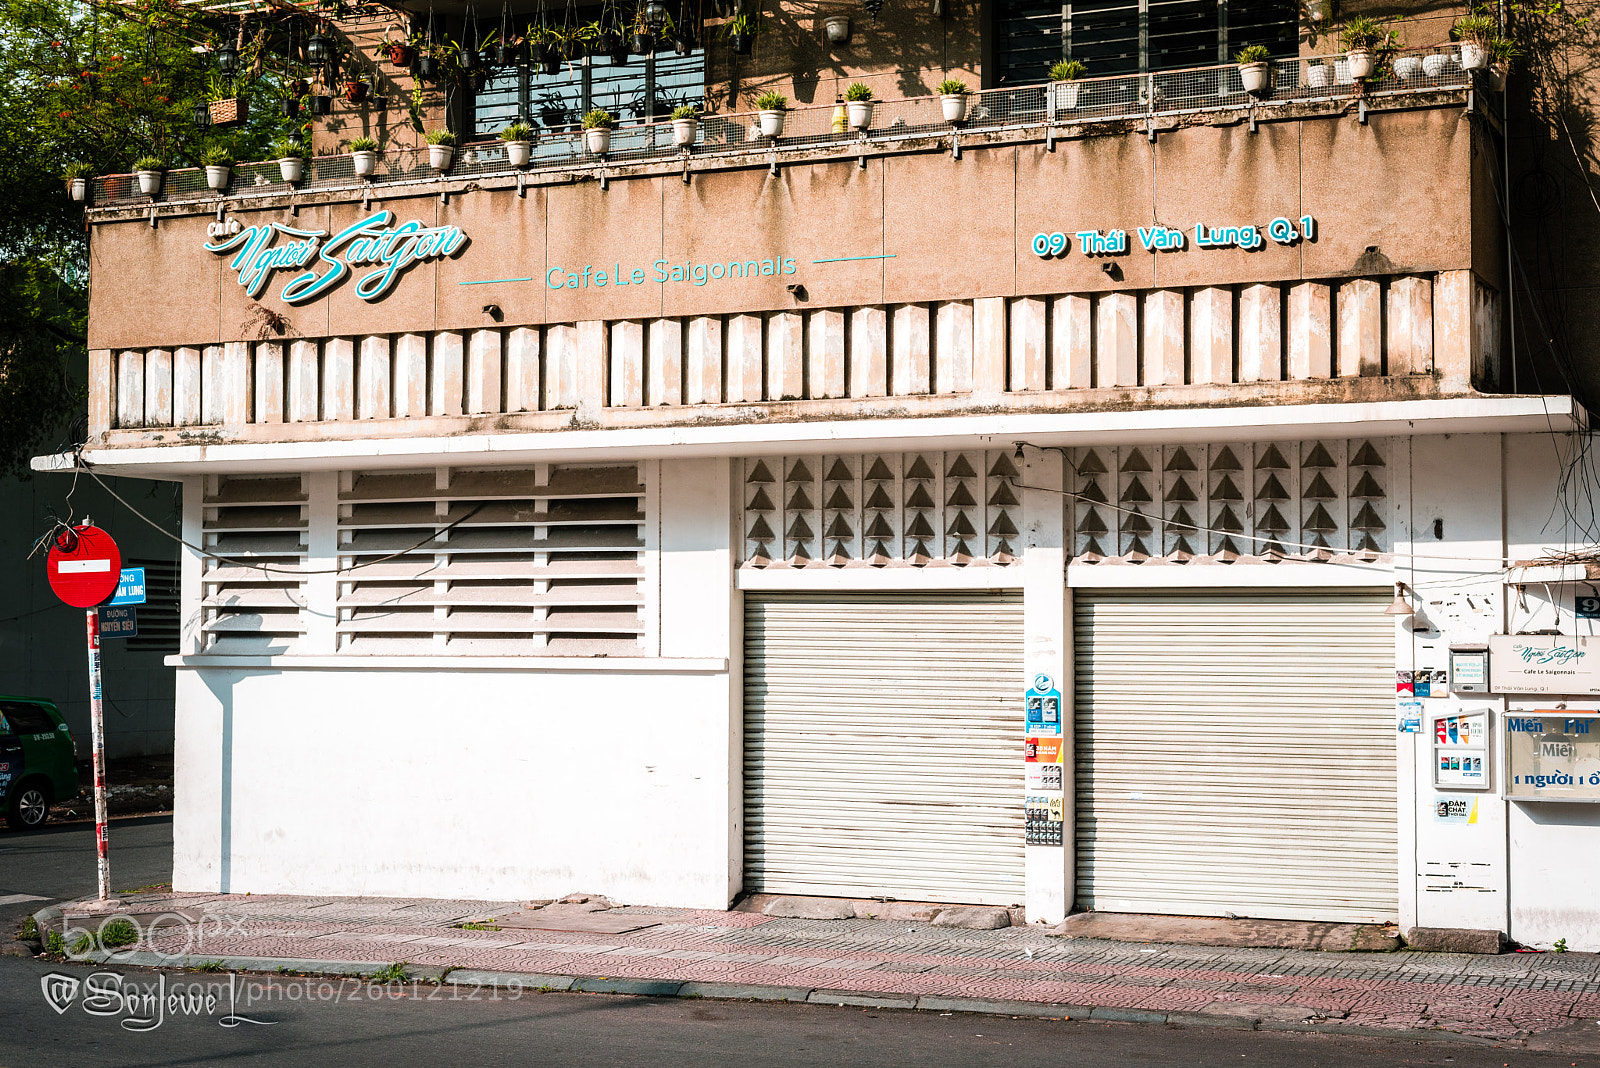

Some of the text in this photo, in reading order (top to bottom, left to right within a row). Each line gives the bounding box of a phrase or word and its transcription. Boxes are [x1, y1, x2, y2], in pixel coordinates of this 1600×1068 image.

[1031, 233, 1068, 256] 09
[1076, 230, 1127, 254] Thái
[1137, 226, 1185, 250] Văn
[1195, 222, 1263, 247] Lung,
[546, 255, 797, 290] Cafe Le Saigonnais
[128, 585, 144, 596] LUNG
[1582, 598, 1600, 612] 9
[1524, 769, 1573, 788] người
